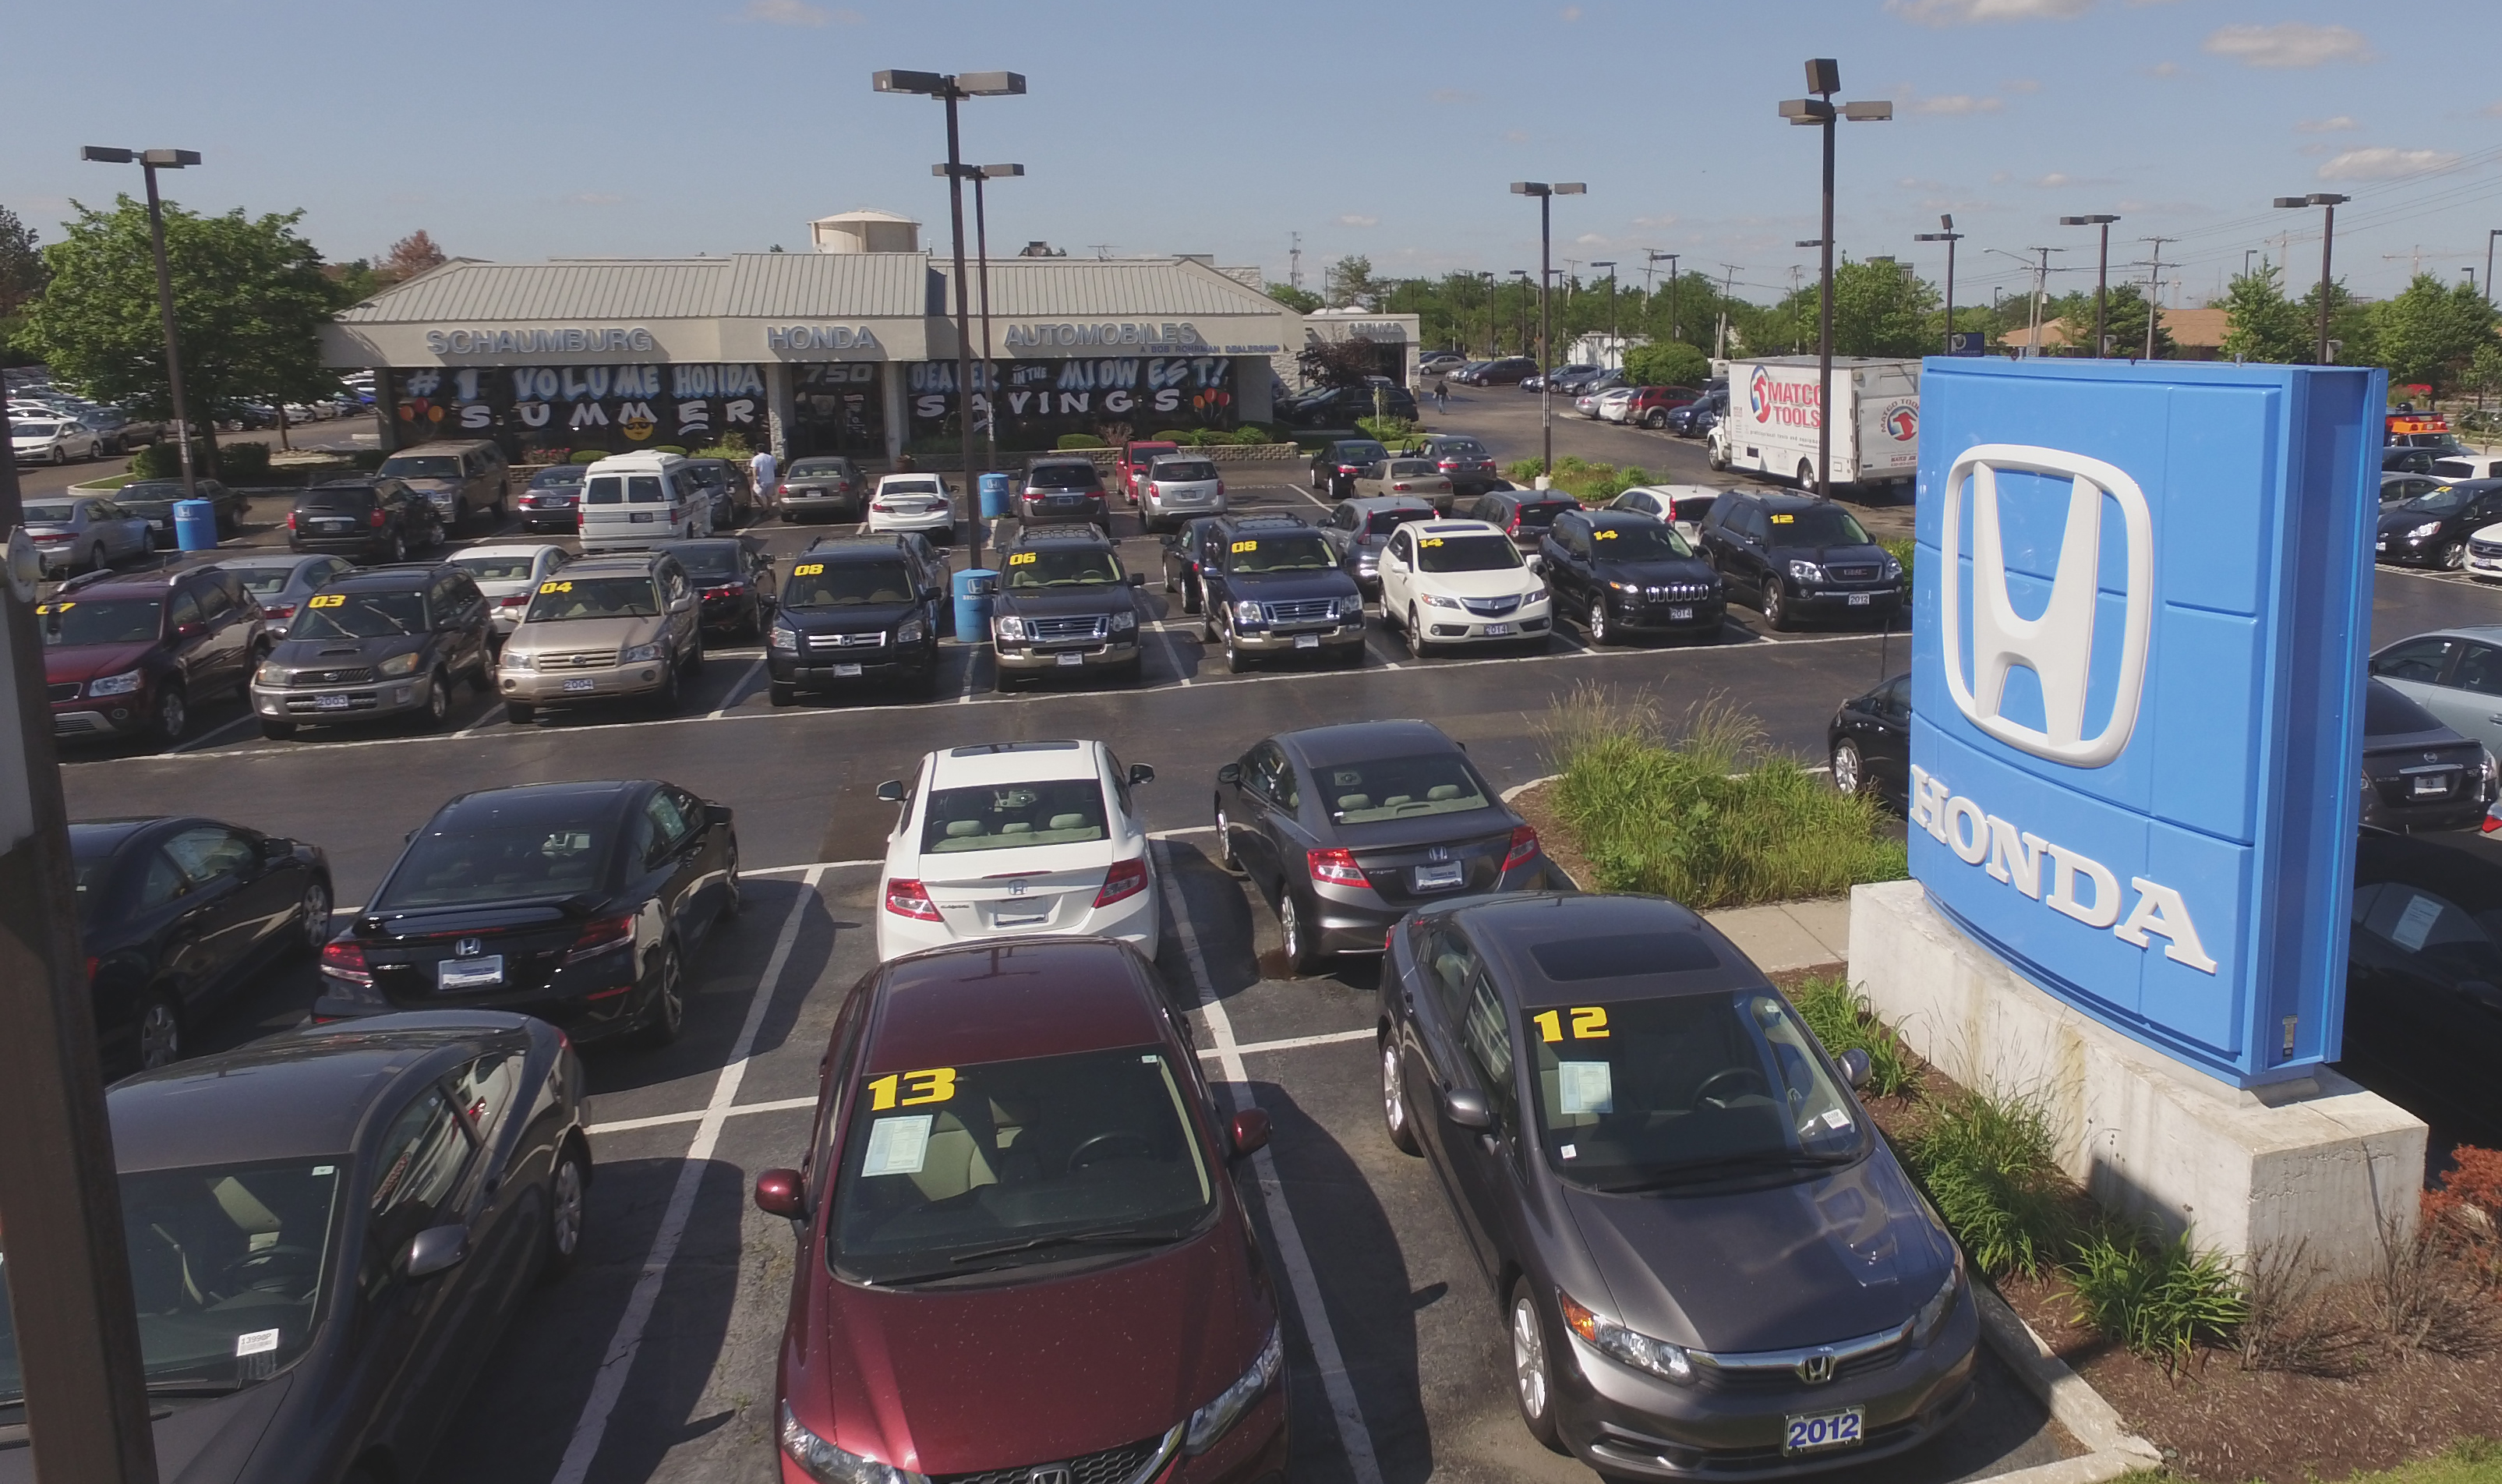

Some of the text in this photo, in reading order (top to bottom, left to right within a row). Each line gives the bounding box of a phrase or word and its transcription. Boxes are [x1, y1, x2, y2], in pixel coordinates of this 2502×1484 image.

[1005, 322, 1197, 346] AUTOMOBILES
[1349, 322, 1401, 334] SERVICE
[426, 328, 653, 354] SCHAUMBURG
[767, 325, 875, 349] HONDA
[1175, 345, 1221, 354] ROHRMAN
[1225, 344, 1280, 354] DEALERSHIP
[803, 364, 874, 383] 750
[911, 361, 999, 392] DEAER
[1027, 366, 1048, 382] THE
[1057, 358, 1230, 390] MIDWEST!
[512, 366, 660, 401] VOLUME
[672, 364, 765, 398] HONDA
[461, 398, 755, 428] SUMMER
[1774, 405, 1820, 428] TOOLS
[1881, 401, 1898, 433] MATCO
[1770, 514, 1794, 524] 12
[1594, 530, 1618, 540] 14
[1232, 540, 1257, 553] 08
[1419, 538, 1444, 549] 14
[1009, 553, 1037, 565] 06
[794, 564, 825, 576] 08
[539, 581, 573, 594] 04
[309, 595, 346, 609] 03
[1850, 595, 1869, 604] 2012
[1671, 609, 1692, 619] 2014
[1486, 624, 1507, 634] 2014
[564, 680, 592, 689] 2004
[317, 694, 347, 706] 2003
[1910, 764, 2218, 974] HONDA
[1534, 1007, 1610, 1043] 12
[868, 1067, 956, 1111] 13
[1788, 1413, 1860, 1447] 2012
